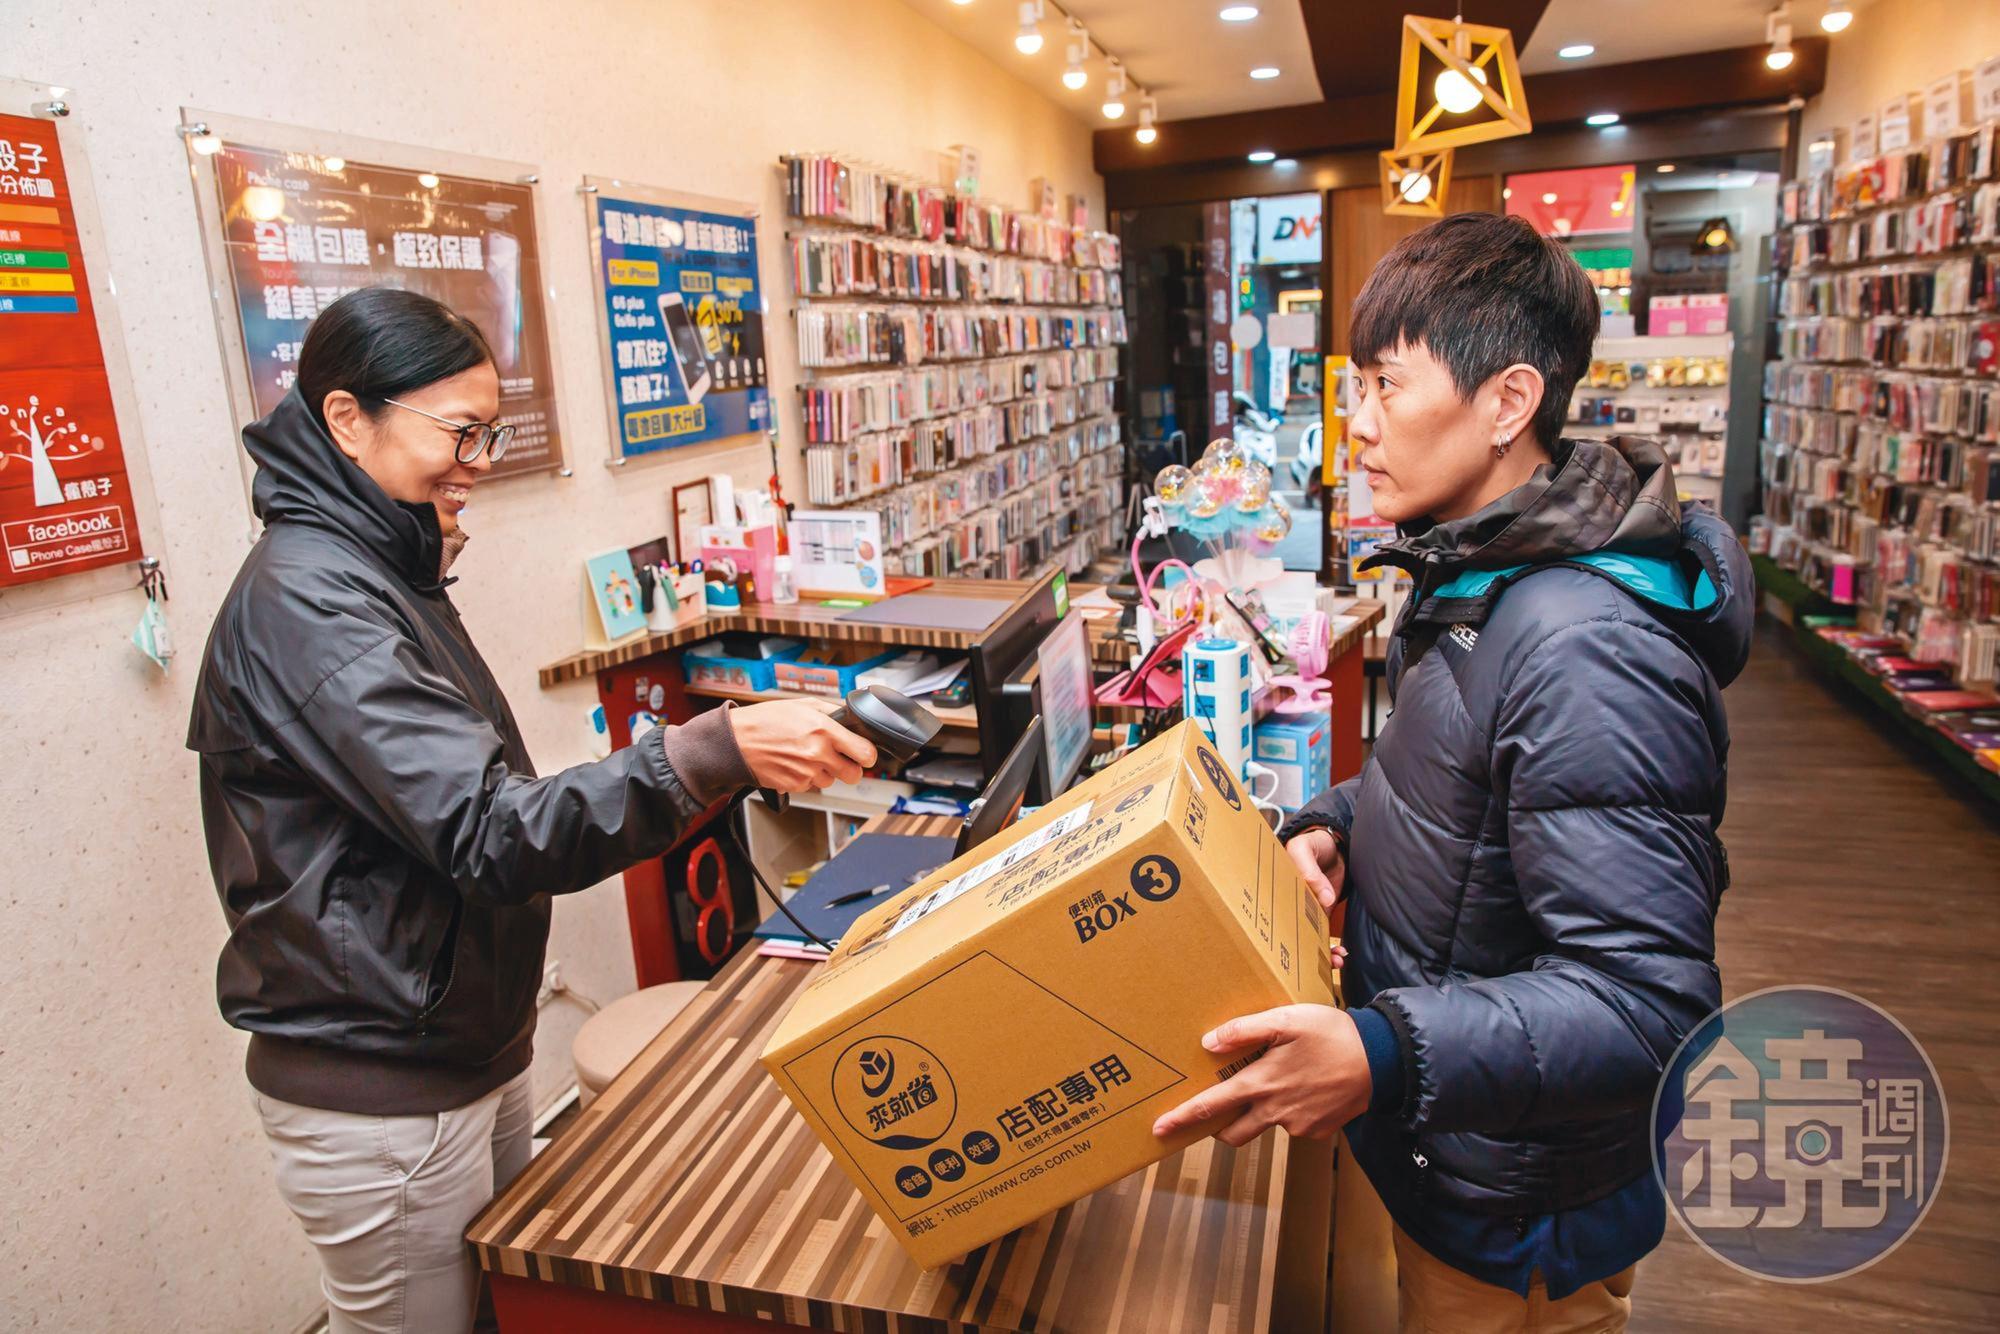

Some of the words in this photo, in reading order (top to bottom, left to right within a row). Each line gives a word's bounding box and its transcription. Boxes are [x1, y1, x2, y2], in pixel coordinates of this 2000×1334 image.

[0, 175, 55, 198] 分佈圖
[28, 513, 112, 542] facebook
[31, 548, 64, 563] Phone
[1068, 889, 1106, 919] 便利箱
[1074, 891, 1137, 944] BOX
[996, 1053, 1132, 1142] 店配專用
[934, 1157, 961, 1176] 便利
[967, 1137, 995, 1158] 效率
